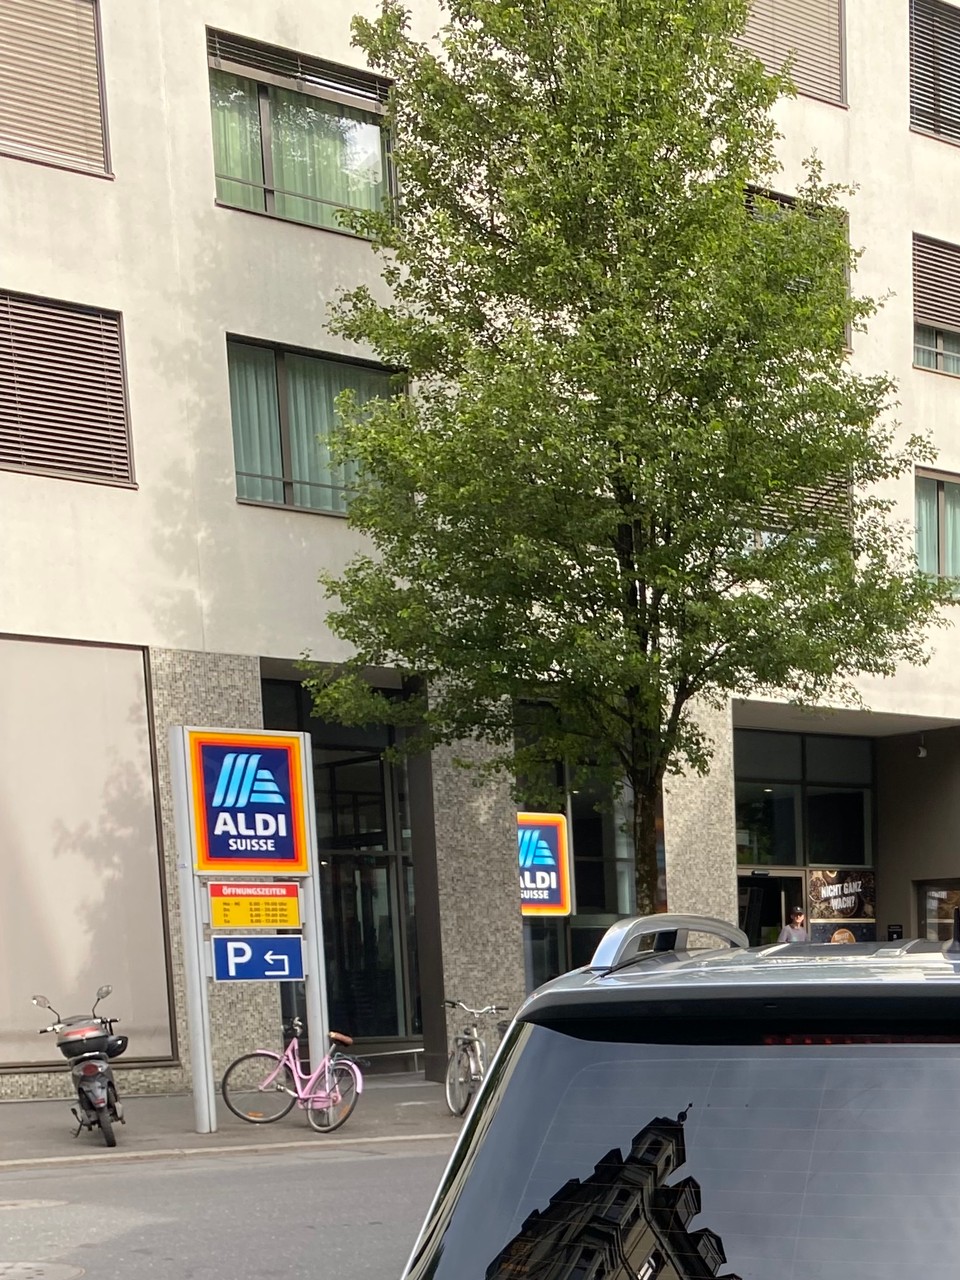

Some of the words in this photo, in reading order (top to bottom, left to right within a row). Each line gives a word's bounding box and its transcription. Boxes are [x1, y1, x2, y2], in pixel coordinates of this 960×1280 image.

[213, 812, 287, 837] ALDI
[228, 838, 276, 851] SUISSE
[222, 885, 287, 895] ÖFFNUNGSZEITEN
[821, 884, 842, 898] NICHT
[843, 881, 862, 895] GANZ
[831, 896, 855, 910] WACH?
[226, 941, 252, 976] P
